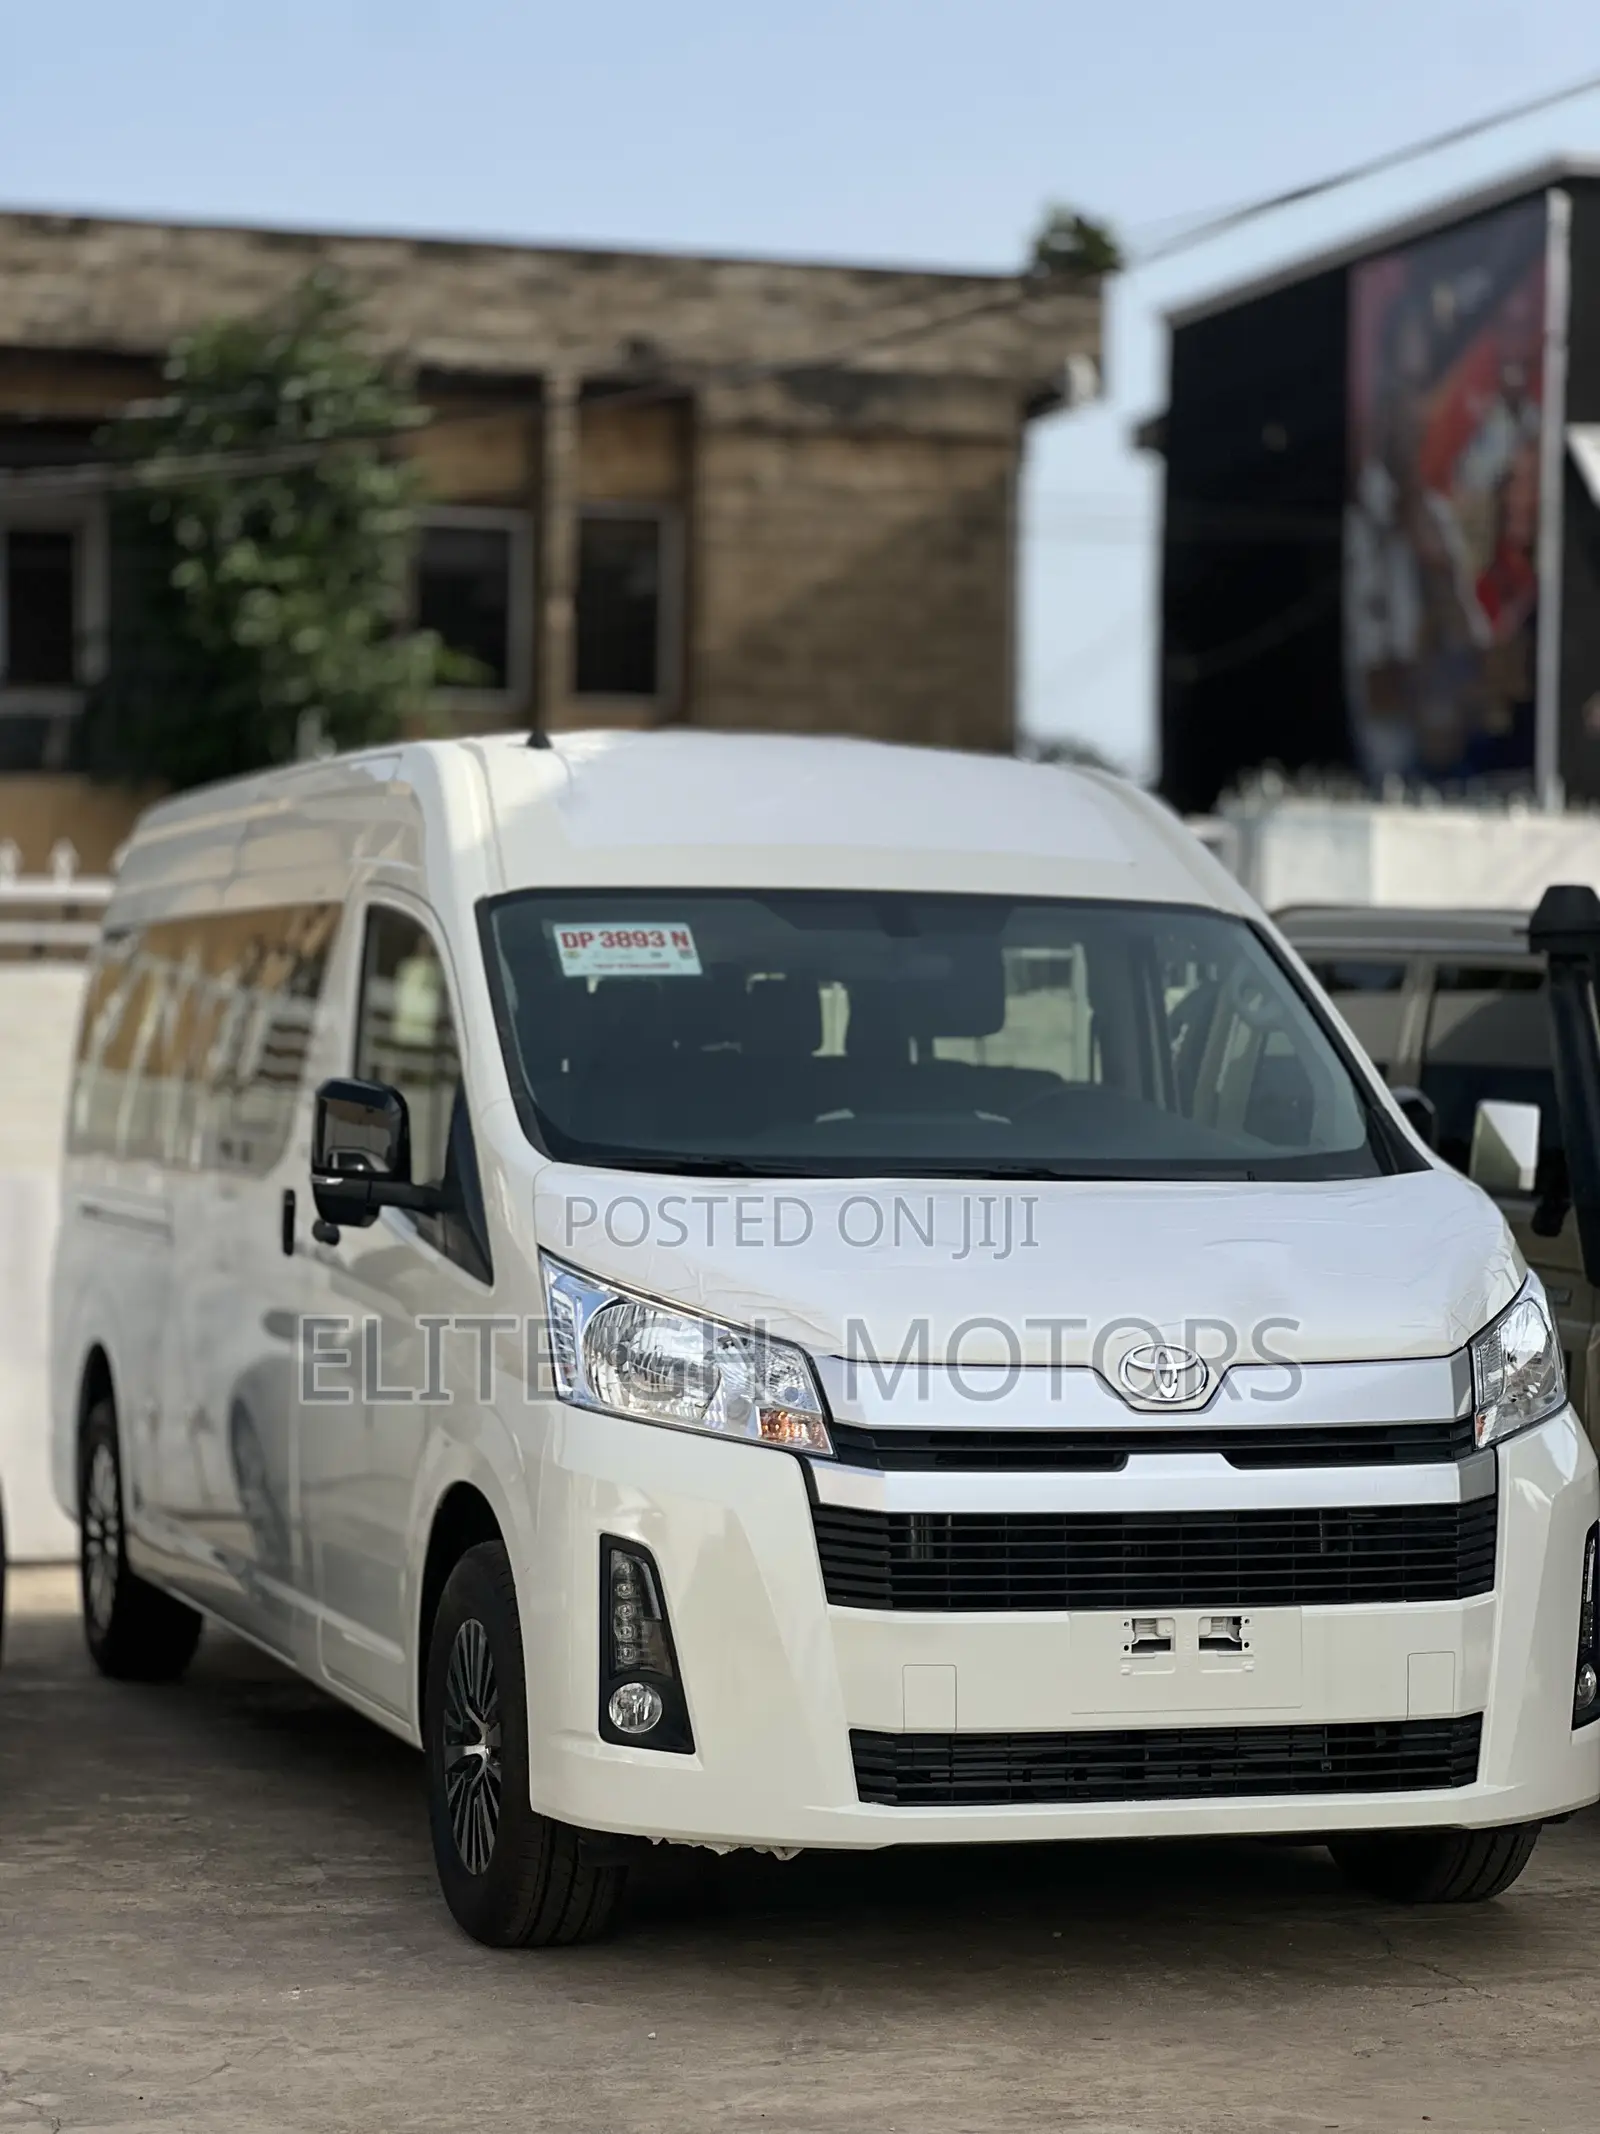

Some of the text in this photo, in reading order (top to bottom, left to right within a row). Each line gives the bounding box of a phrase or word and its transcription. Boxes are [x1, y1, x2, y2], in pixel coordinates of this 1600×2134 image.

[560, 930, 690, 948] DP 3893 N
